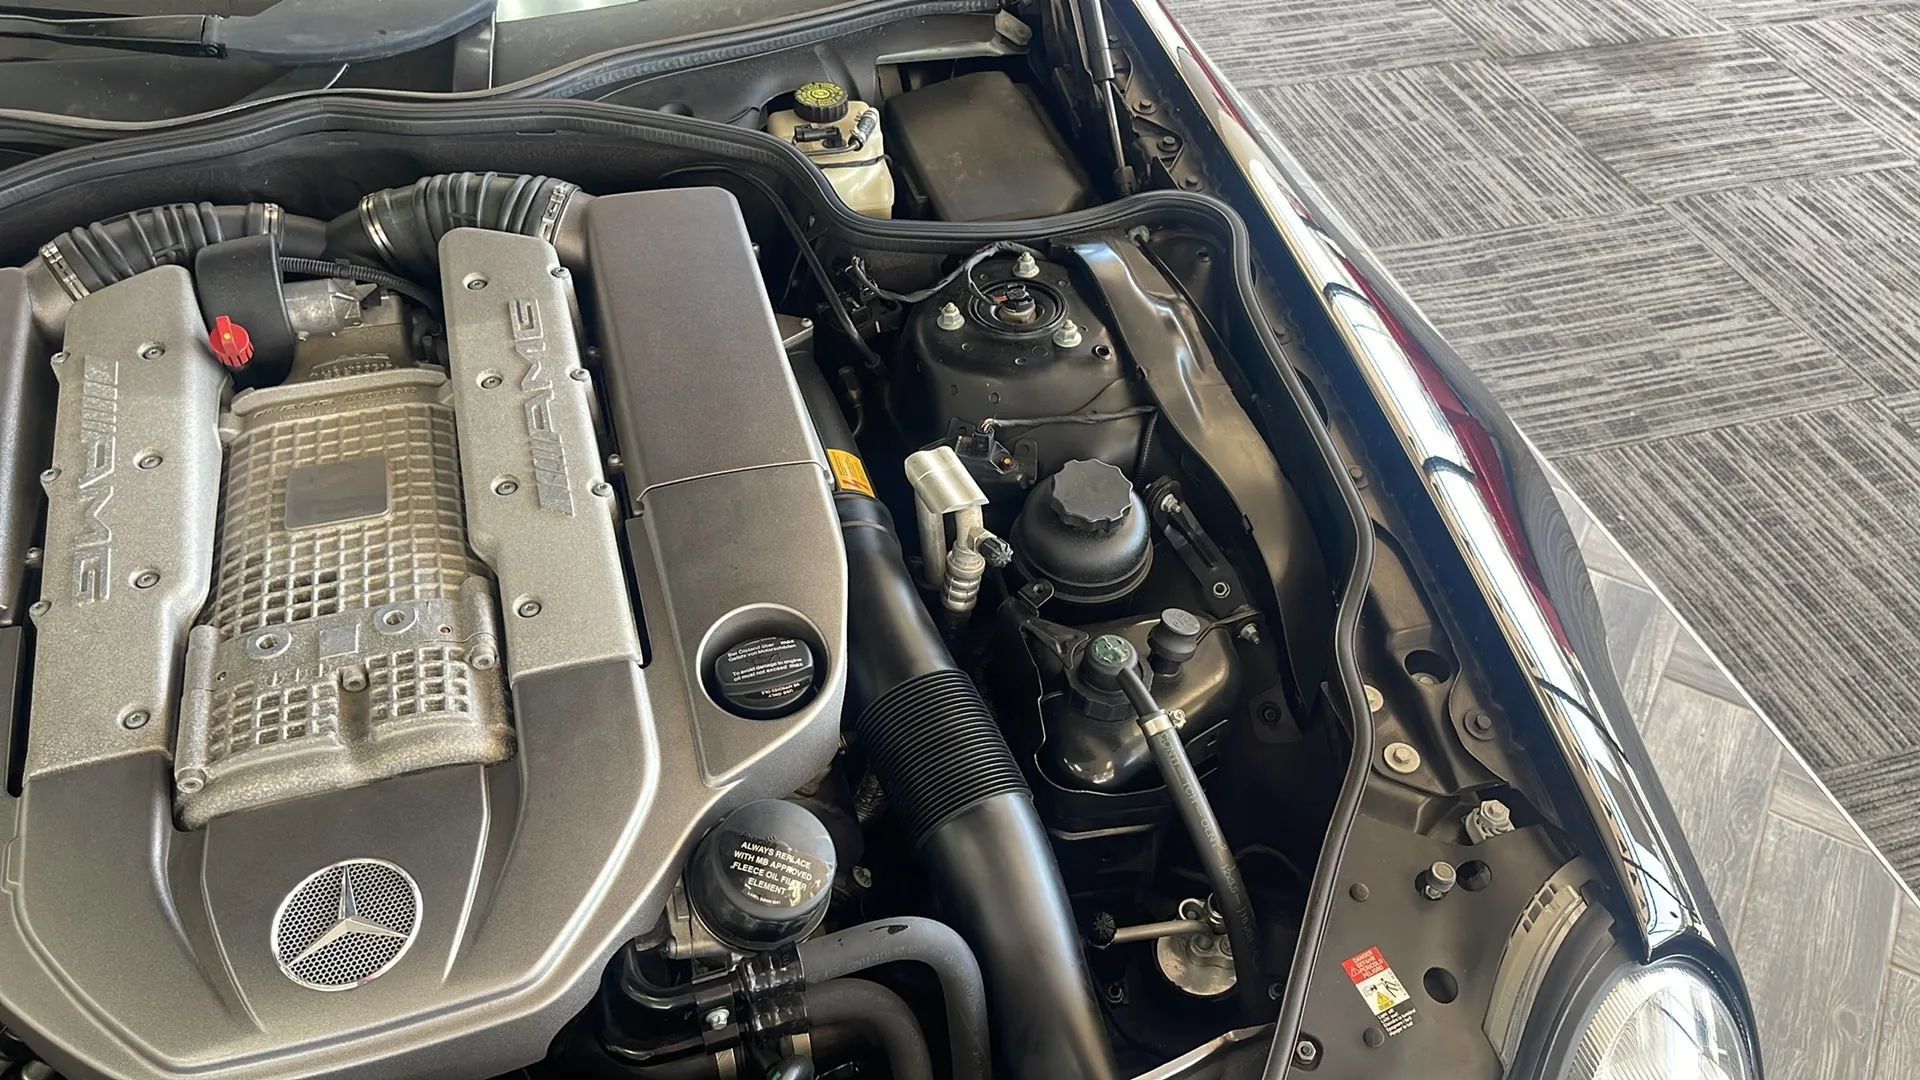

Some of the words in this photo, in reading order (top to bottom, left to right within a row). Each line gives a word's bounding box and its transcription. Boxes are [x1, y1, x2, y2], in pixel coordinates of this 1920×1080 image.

[741, 666, 755, 675] avoid
[756, 662, 777, 672] damage
[784, 657, 802, 665] engine
[742, 672, 756, 681] must
[766, 665, 787, 673] exceed
[740, 841, 775, 856] ALWAYS
[776, 851, 812, 869] REPLACE
[732, 861, 765, 877] FLEECE
[765, 871, 779, 881] OIL
[734, 850, 755, 862] WITH
[755, 856, 769, 866] MB
[770, 861, 812, 881] APPROVED
[748, 878, 787, 895] ELEMENT
